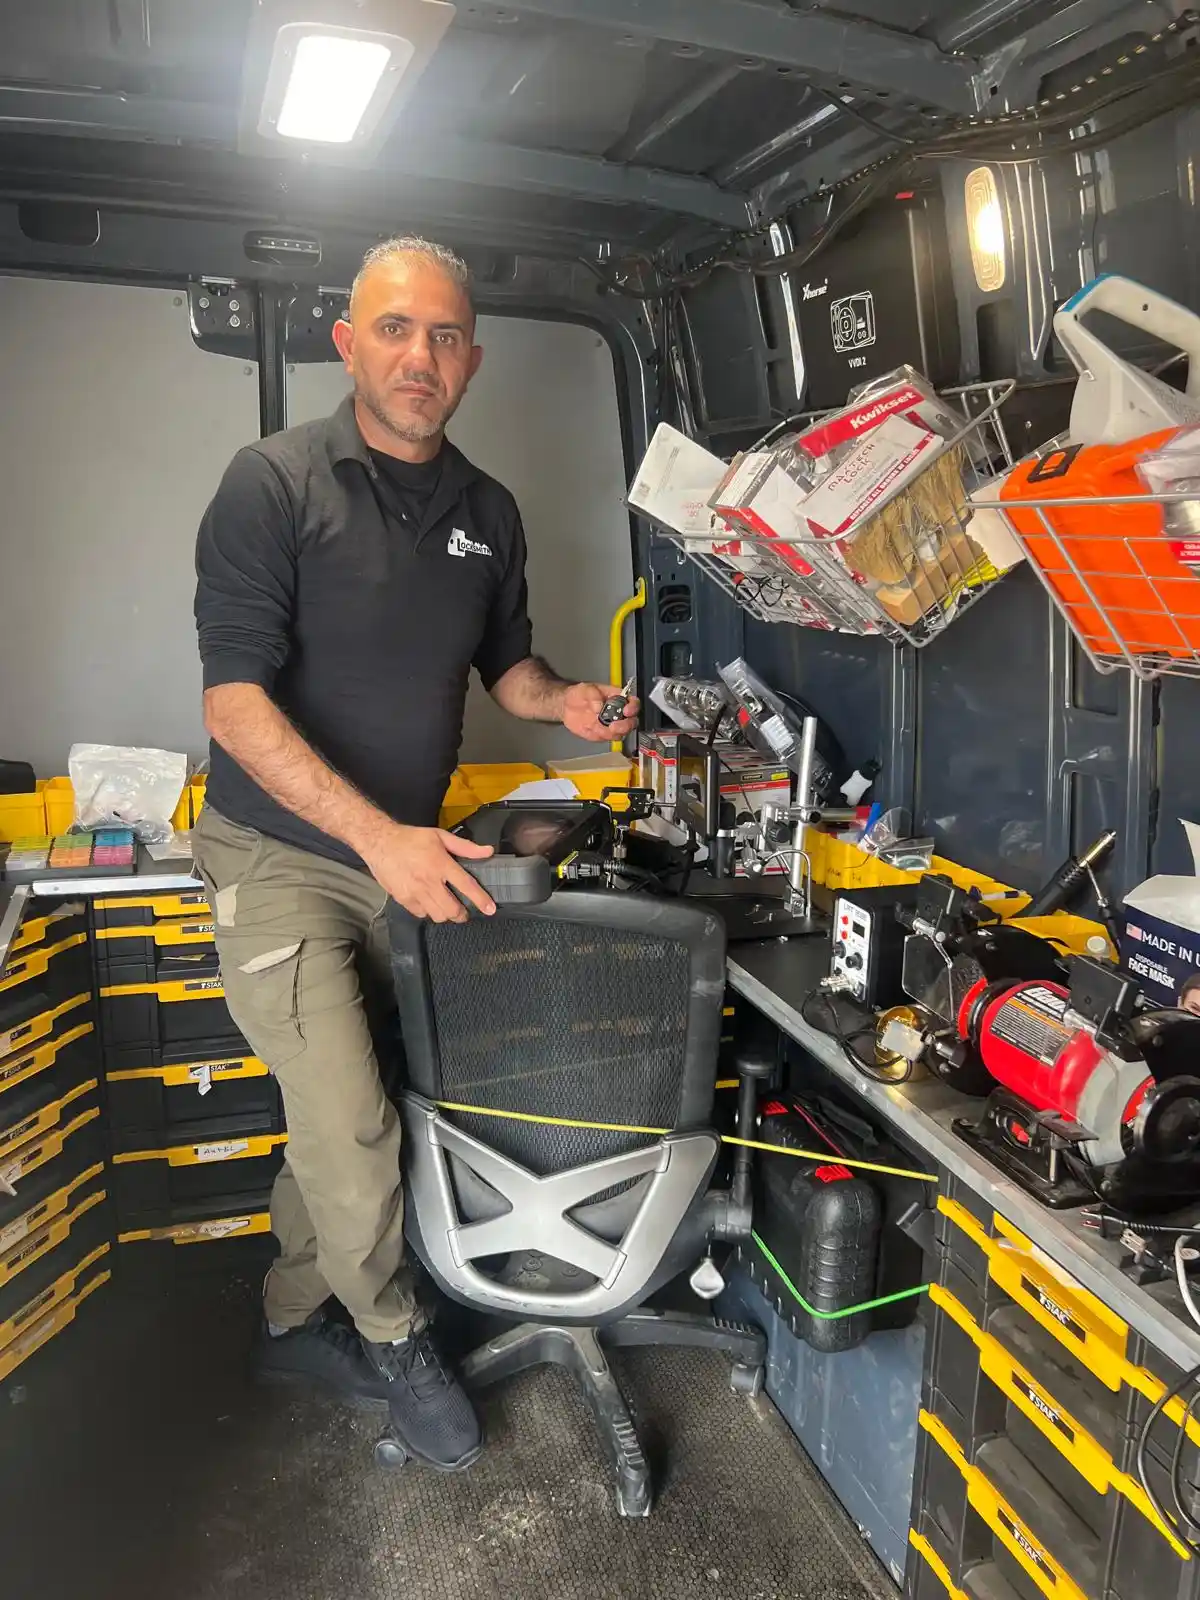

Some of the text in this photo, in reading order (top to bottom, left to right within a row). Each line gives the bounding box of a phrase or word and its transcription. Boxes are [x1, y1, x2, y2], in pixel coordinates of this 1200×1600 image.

[803, 283, 828, 301] Xhorse
[850, 391, 916, 430] Kwikset
[843, 457, 872, 484] LOCK
[1142, 930, 1177, 956] MADE
[1178, 946, 1193, 963] IN
[1128, 957, 1175, 989] FACE MASK
[1135, 953, 1168, 974] DISPOSABLE
